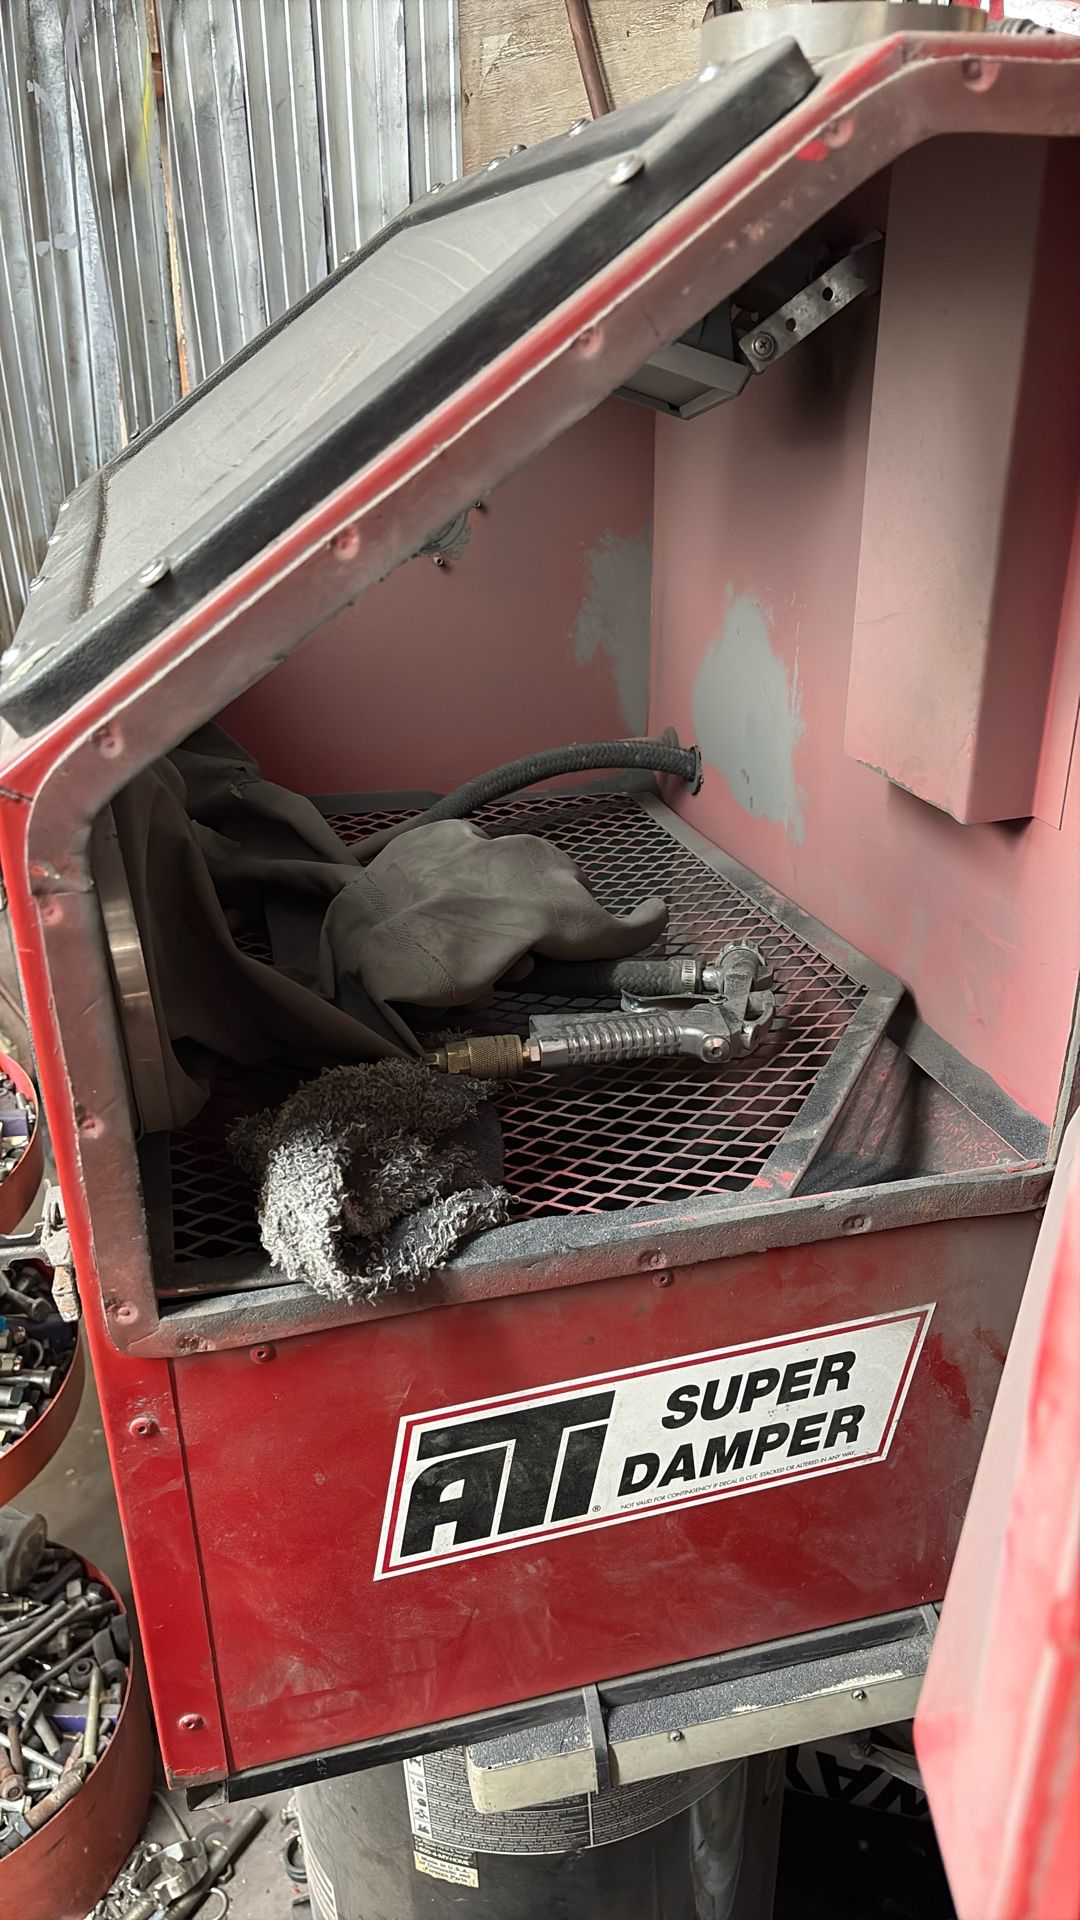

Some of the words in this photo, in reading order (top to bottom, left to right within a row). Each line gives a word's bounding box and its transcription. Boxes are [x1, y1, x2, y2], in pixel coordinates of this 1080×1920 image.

[661, 1350, 857, 1430] SUPER
[400, 1390, 616, 1557] ATI
[616, 1404, 866, 1497] DAMPER
[620, 1502, 635, 1510] NOT
[636, 1498, 653, 1507] VALID
[653, 1495, 667, 1503] FOR
[667, 1484, 712, 1500] CONTINGENCY
[719, 1478, 738, 1488] DECAL
[759, 1467, 785, 1478] STACKED
[795, 1459, 820, 1469] ALTERED
[828, 1453, 842, 1461] ANY
